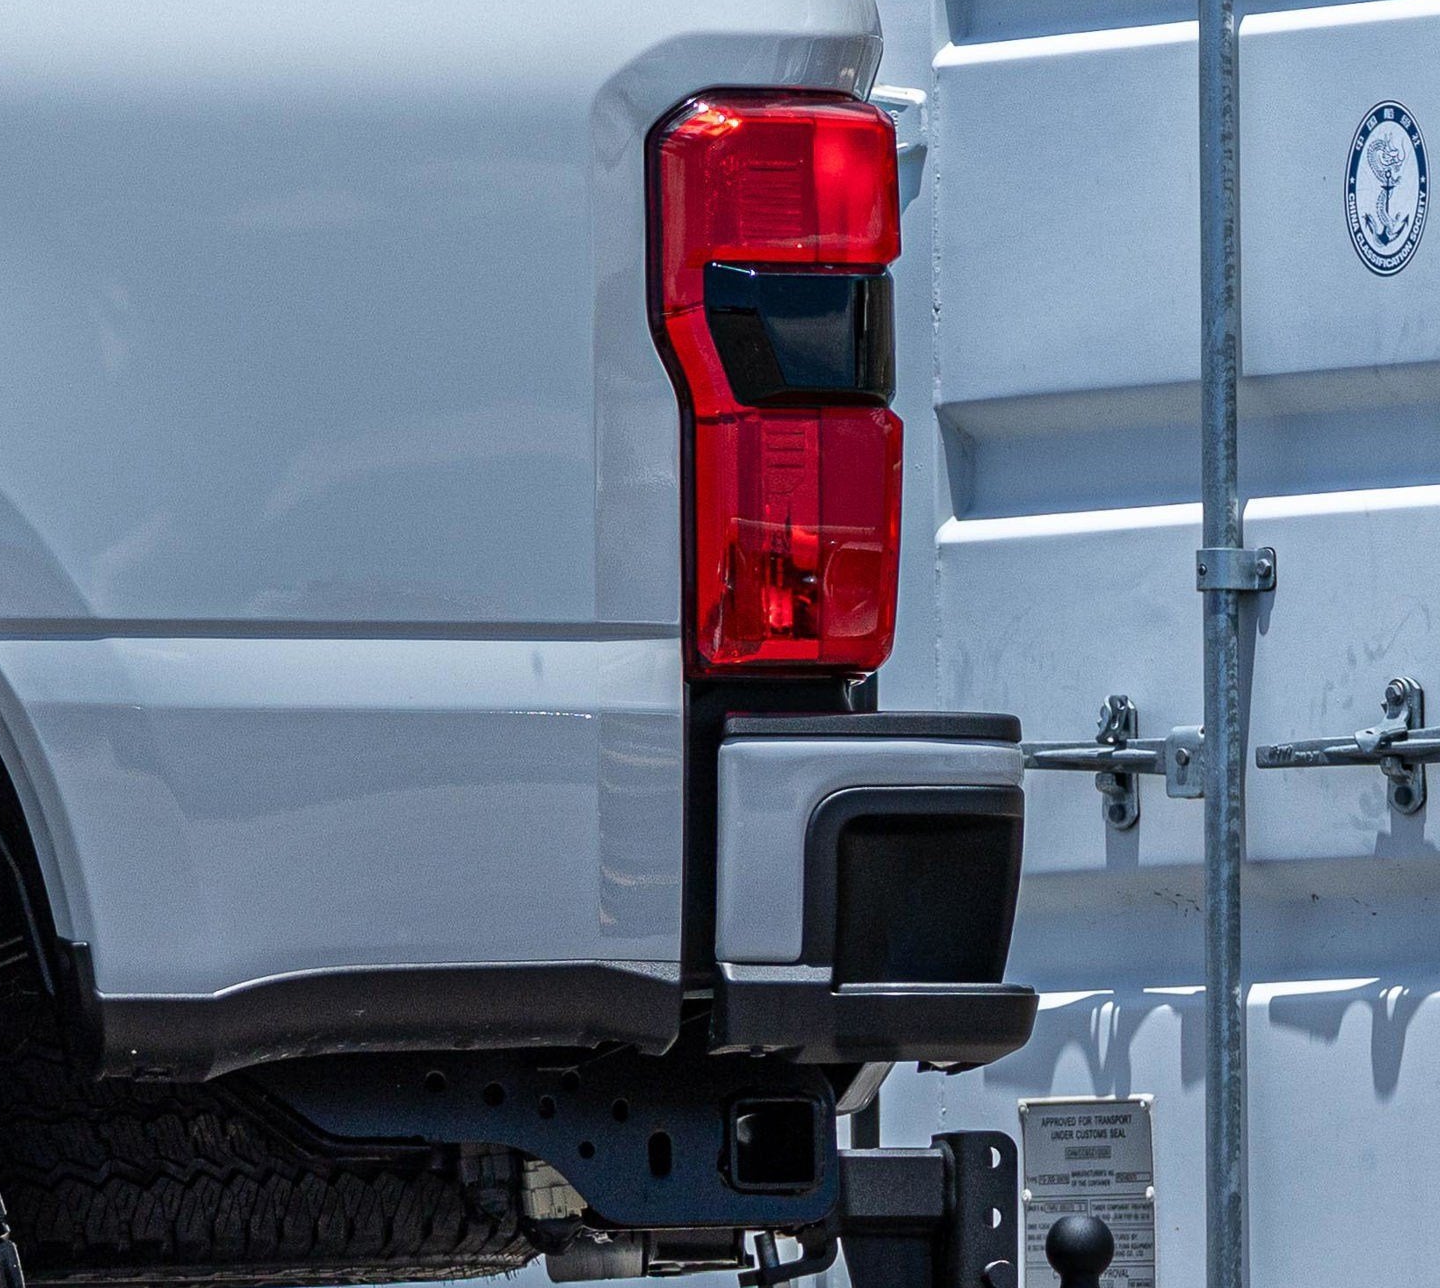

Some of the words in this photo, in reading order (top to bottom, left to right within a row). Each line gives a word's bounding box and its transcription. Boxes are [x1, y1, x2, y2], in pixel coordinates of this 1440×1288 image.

[1041, 1115, 1077, 1127] APPROVED
[1078, 1115, 1093, 1126] FOR
[1094, 1114, 1132, 1125] TRANSPORT
[1050, 1130, 1075, 1141] UNDER
[1075, 1129, 1108, 1140] CUSTOMS
[1110, 1129, 1127, 1138] SEAL
